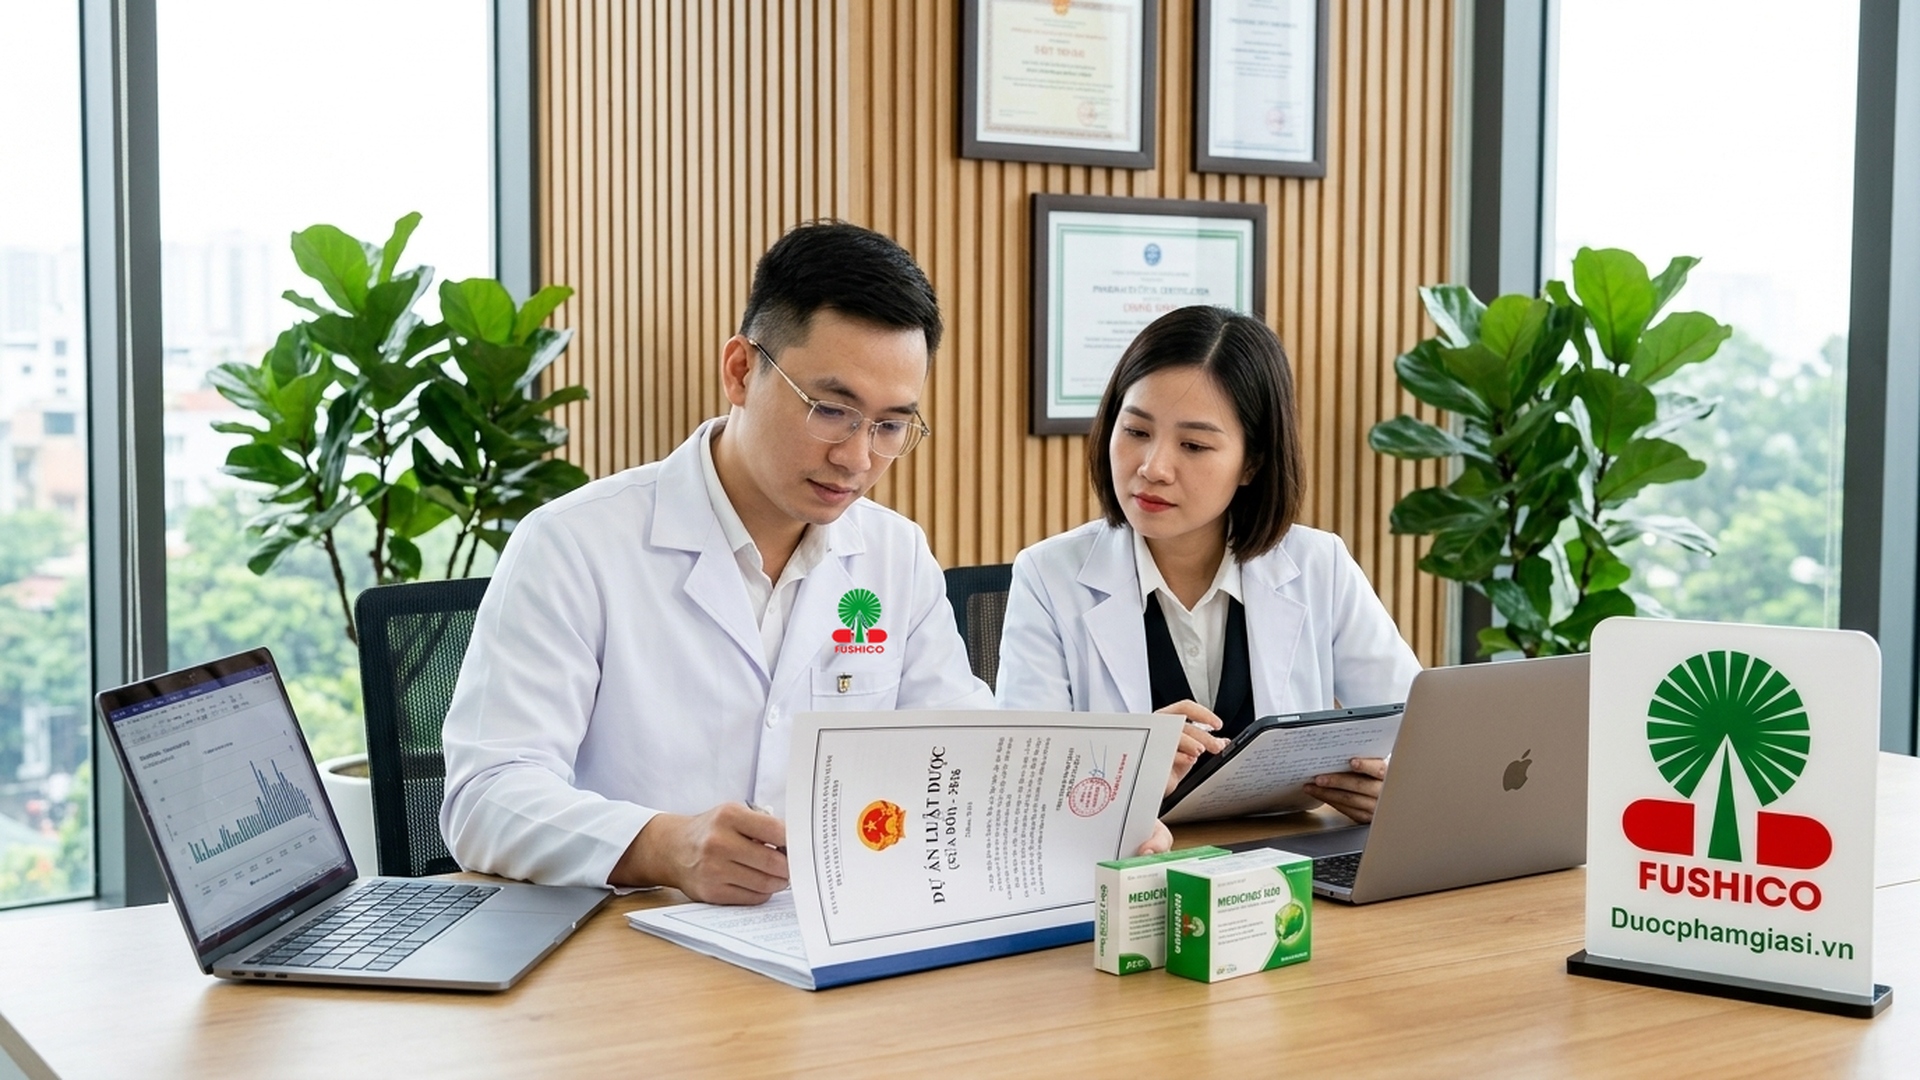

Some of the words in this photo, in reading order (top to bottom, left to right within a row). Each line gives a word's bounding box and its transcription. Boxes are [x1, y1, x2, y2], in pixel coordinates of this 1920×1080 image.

[834, 645, 885, 654] FUSHICO
[924, 849, 942, 872] ÁN
[929, 878, 946, 904] DỰ
[1638, 861, 1822, 911] FUSHICO
[1611, 907, 1854, 960] Duocphamgiasi.vn
